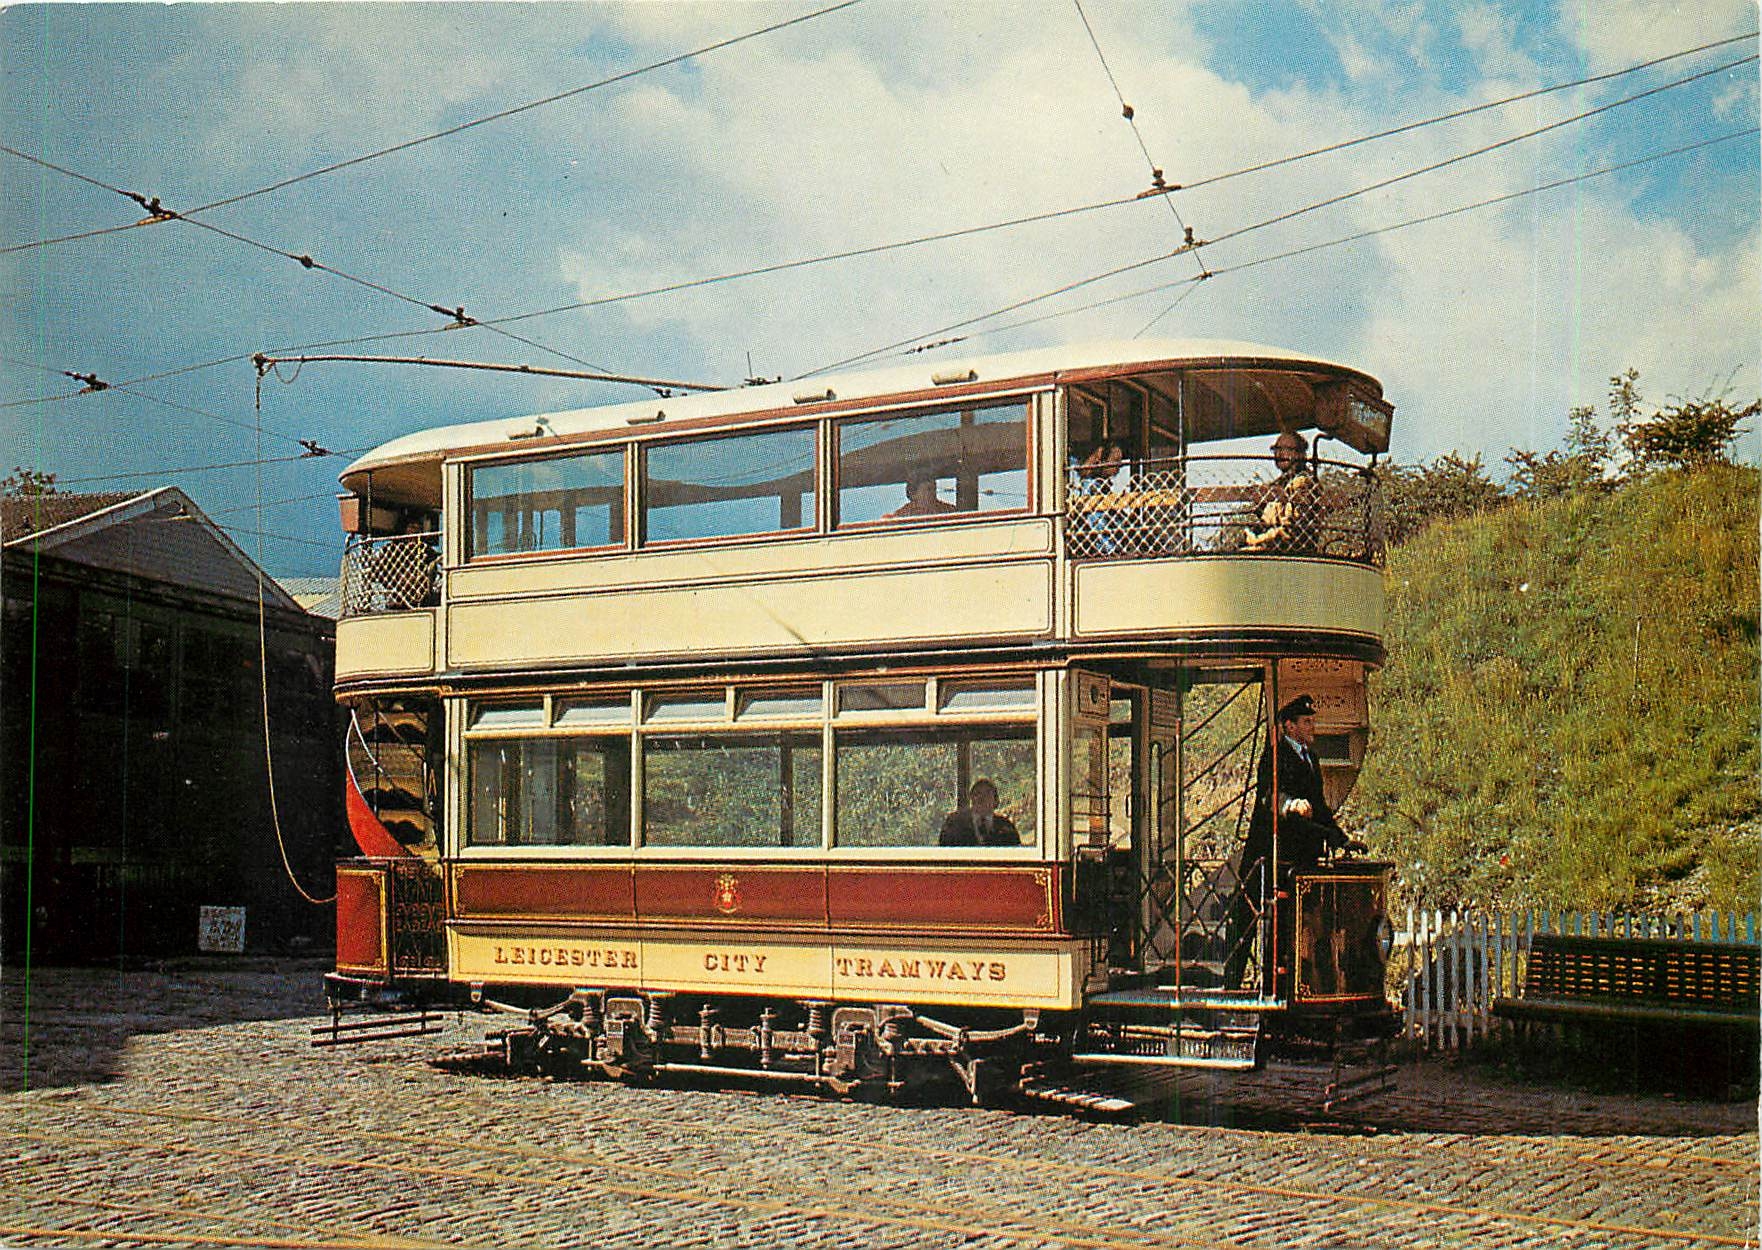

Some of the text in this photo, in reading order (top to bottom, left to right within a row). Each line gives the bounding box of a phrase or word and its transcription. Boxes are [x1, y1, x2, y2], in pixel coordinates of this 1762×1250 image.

[494, 947, 1006, 981] LEICESTER CITY TRAMWAYS
